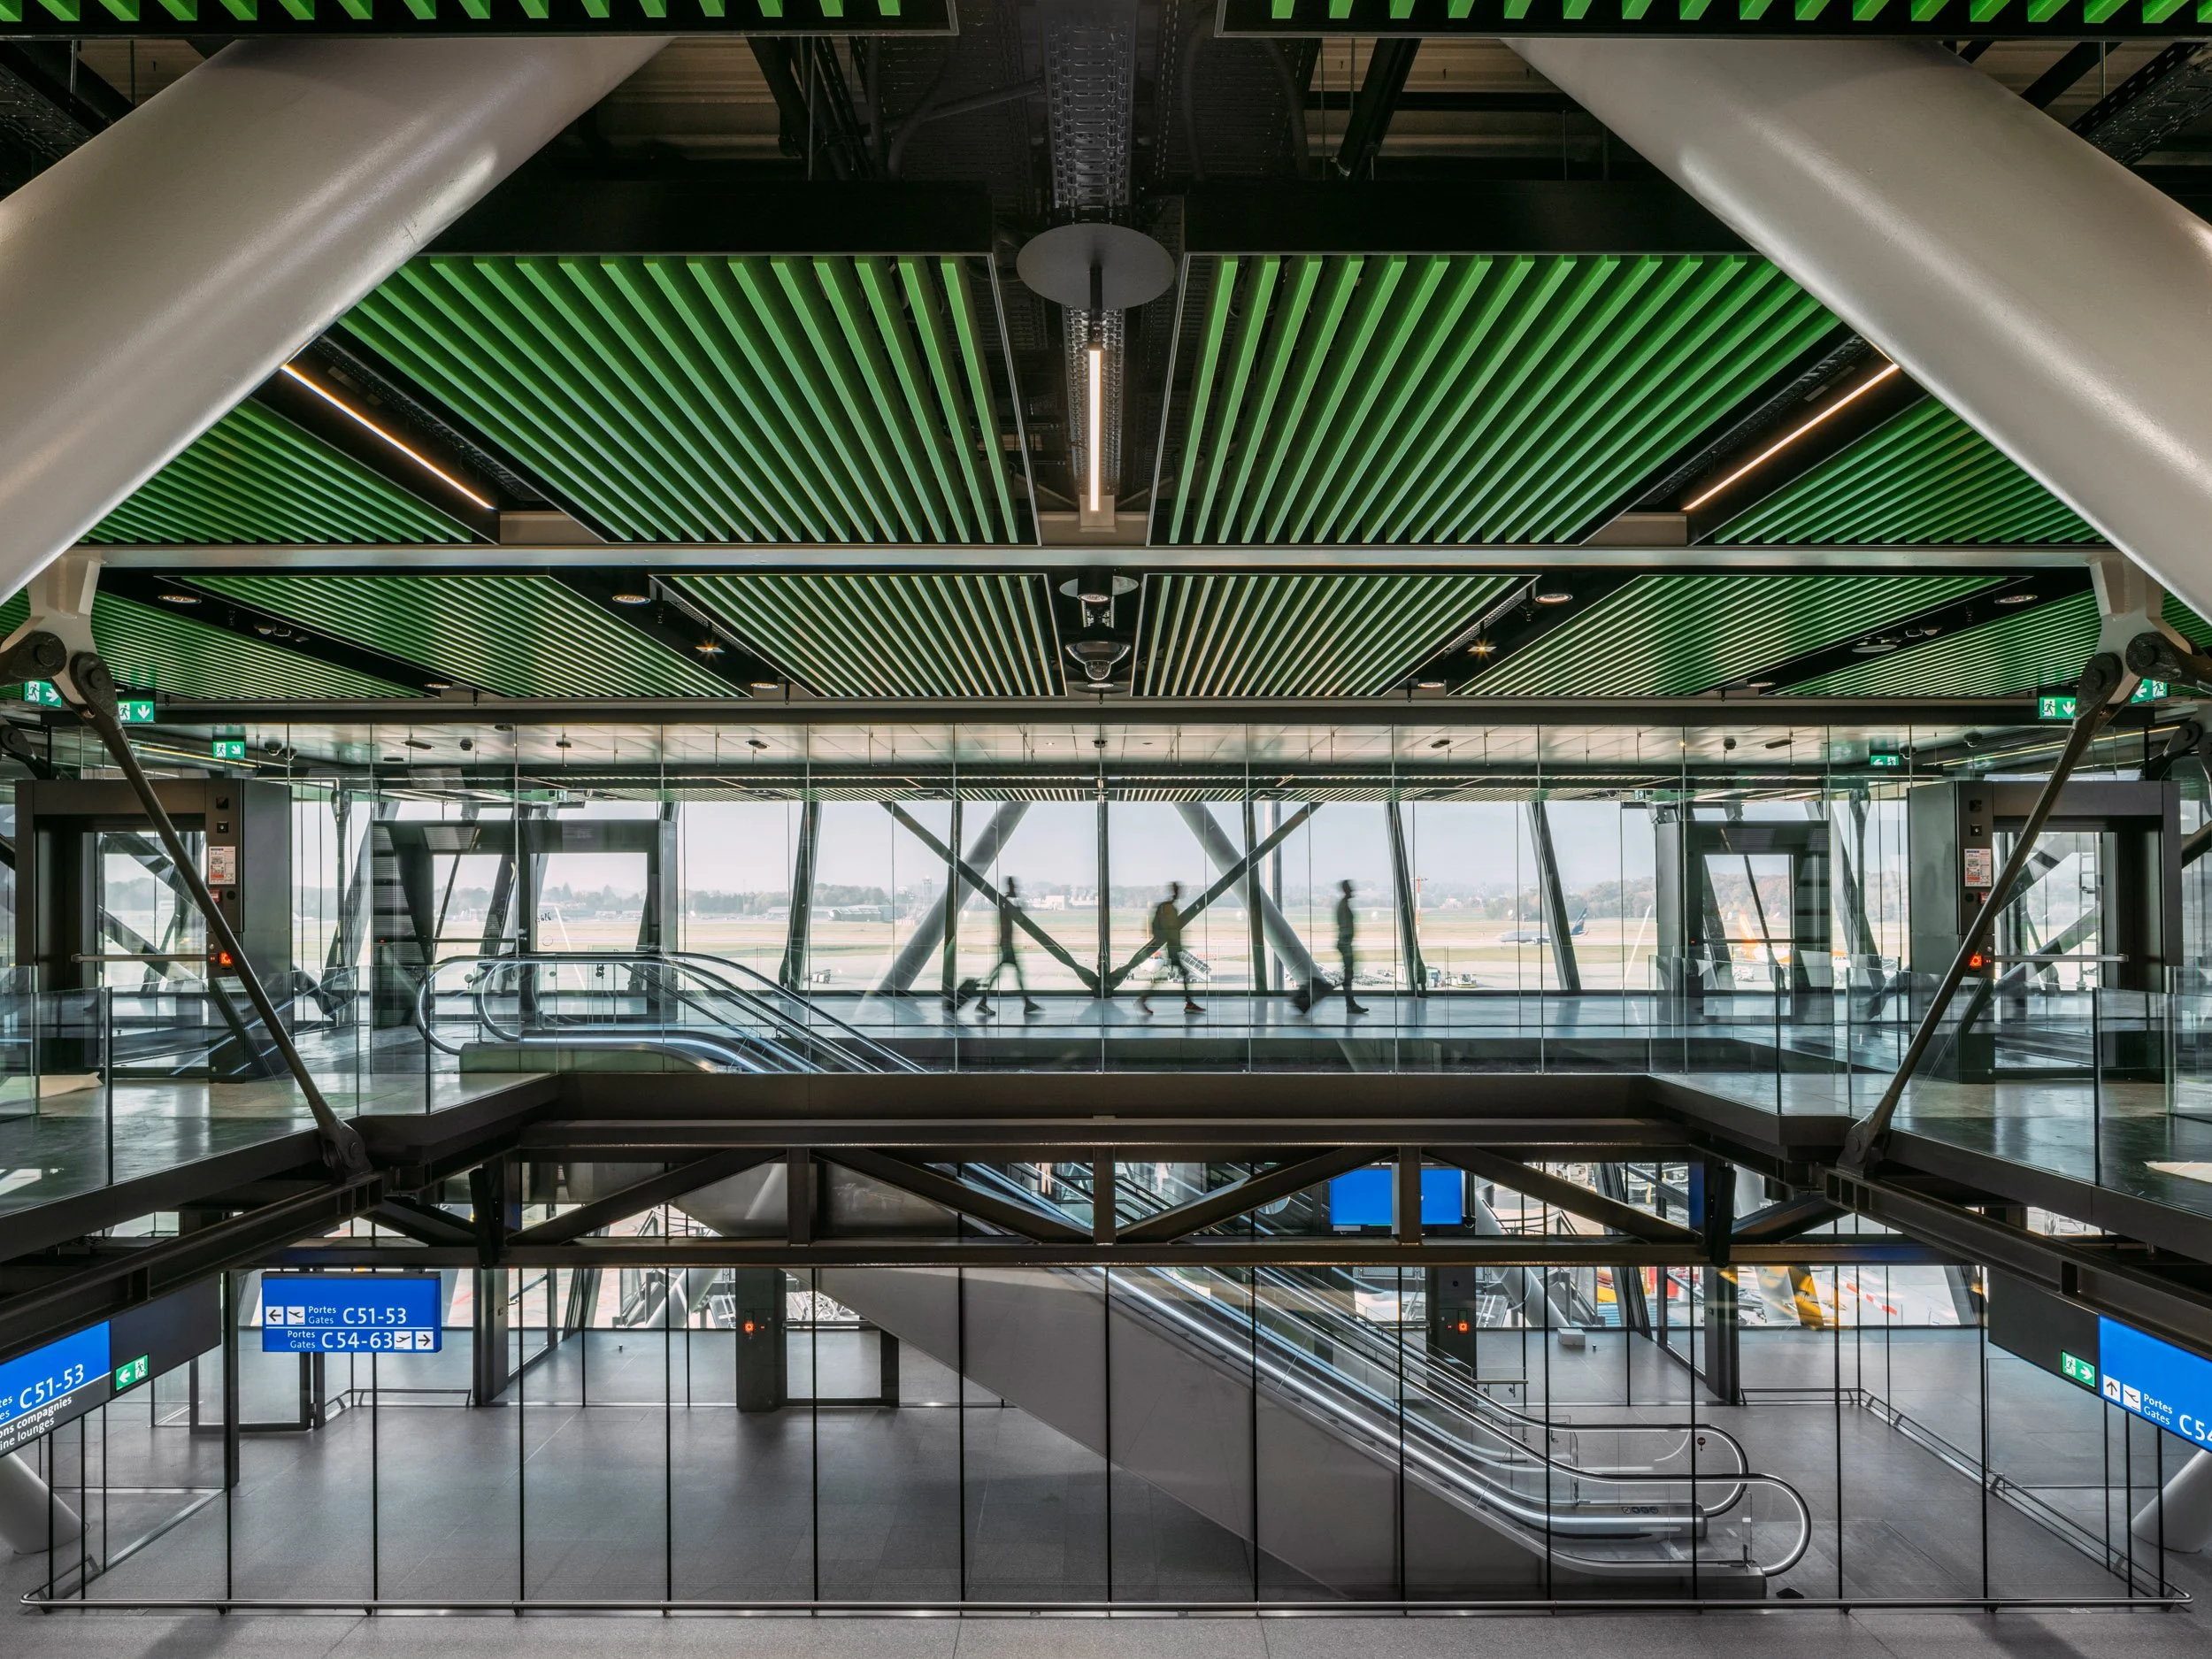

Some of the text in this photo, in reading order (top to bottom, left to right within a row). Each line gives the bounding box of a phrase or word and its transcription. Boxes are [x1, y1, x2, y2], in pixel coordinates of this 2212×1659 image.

[17, 1396, 73, 1429] compagnies
[2144, 1394, 2173, 1414] Portes
[2144, 1406, 2170, 1425] Gates
[18, 1417, 55, 1441] lounges
